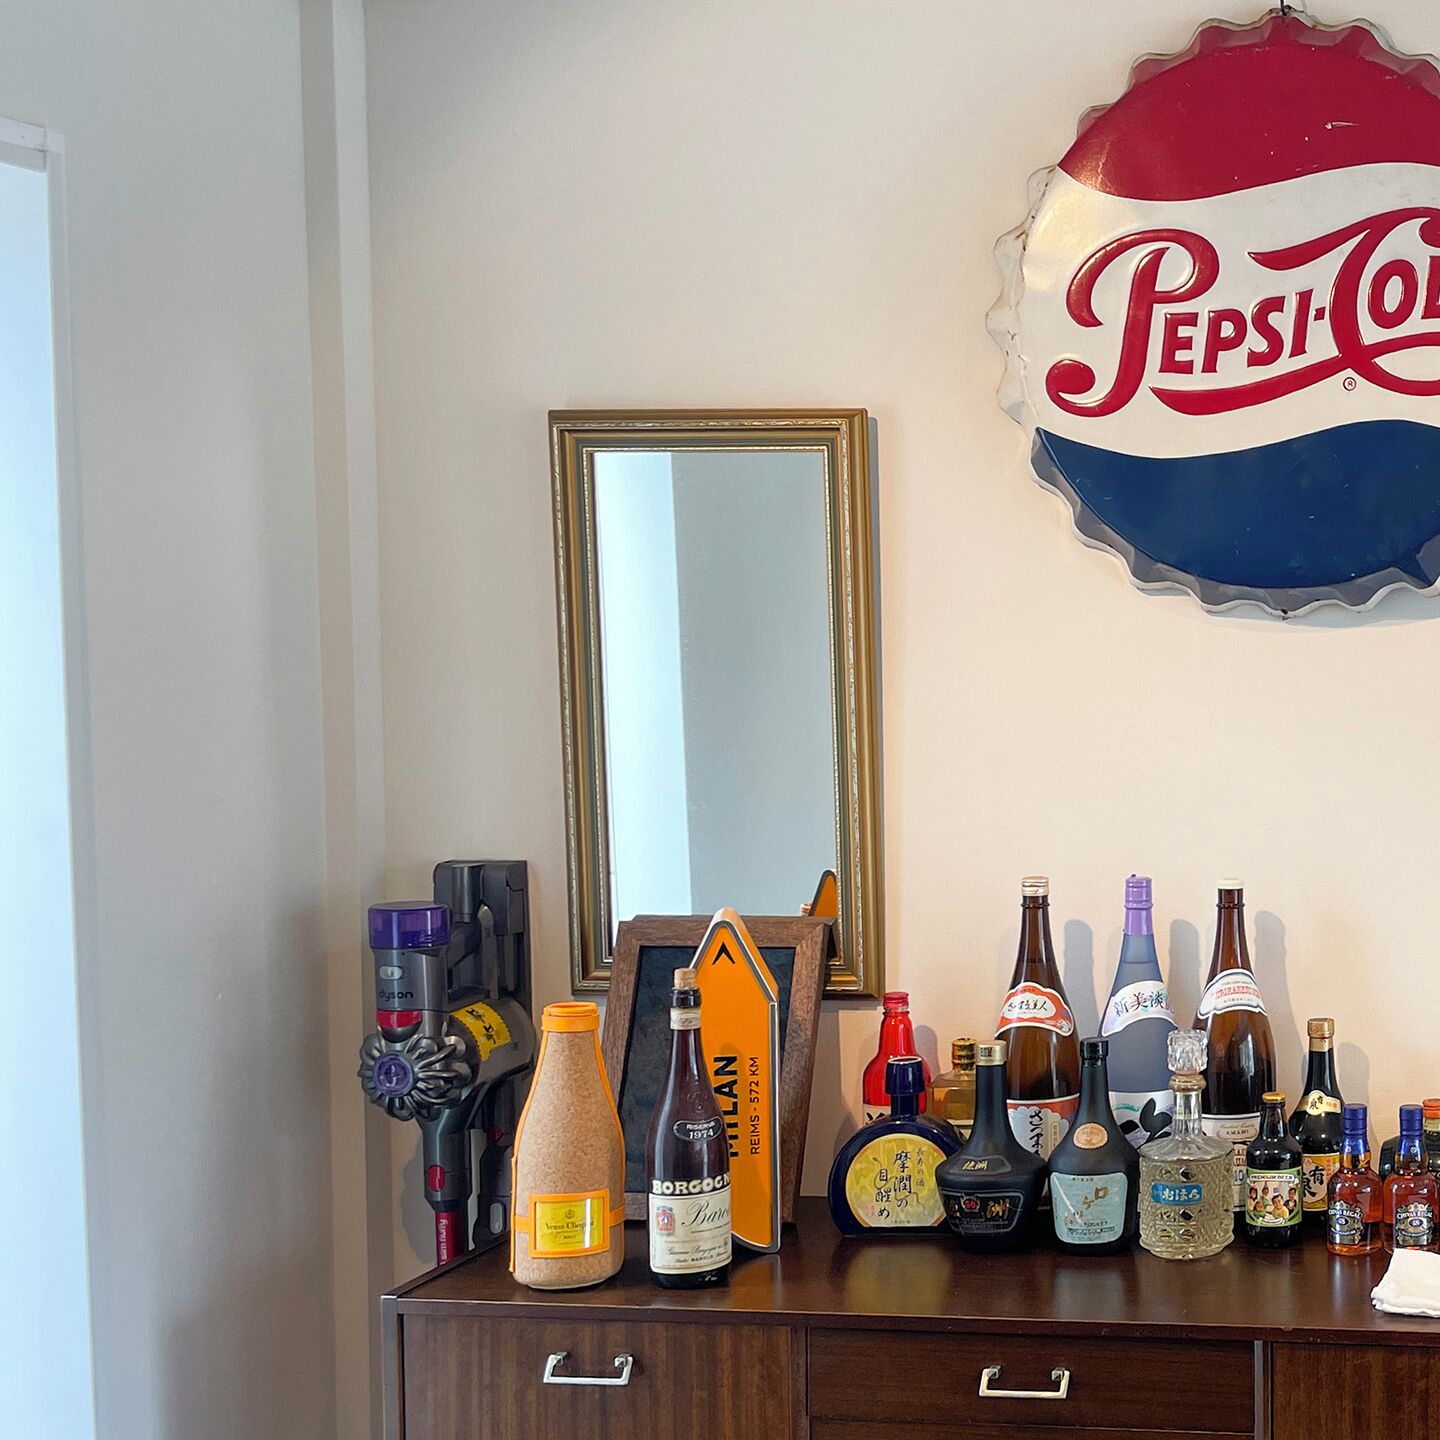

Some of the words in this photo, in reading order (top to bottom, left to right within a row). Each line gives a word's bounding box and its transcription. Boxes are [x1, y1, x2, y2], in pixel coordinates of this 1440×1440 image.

[379, 987, 414, 1001] dyson
[748, 1057, 759, 1076] KM
[749, 1080, 760, 1103] 572
[688, 1128, 714, 1139] 1974
[749, 1115, 760, 1155] REIMS
